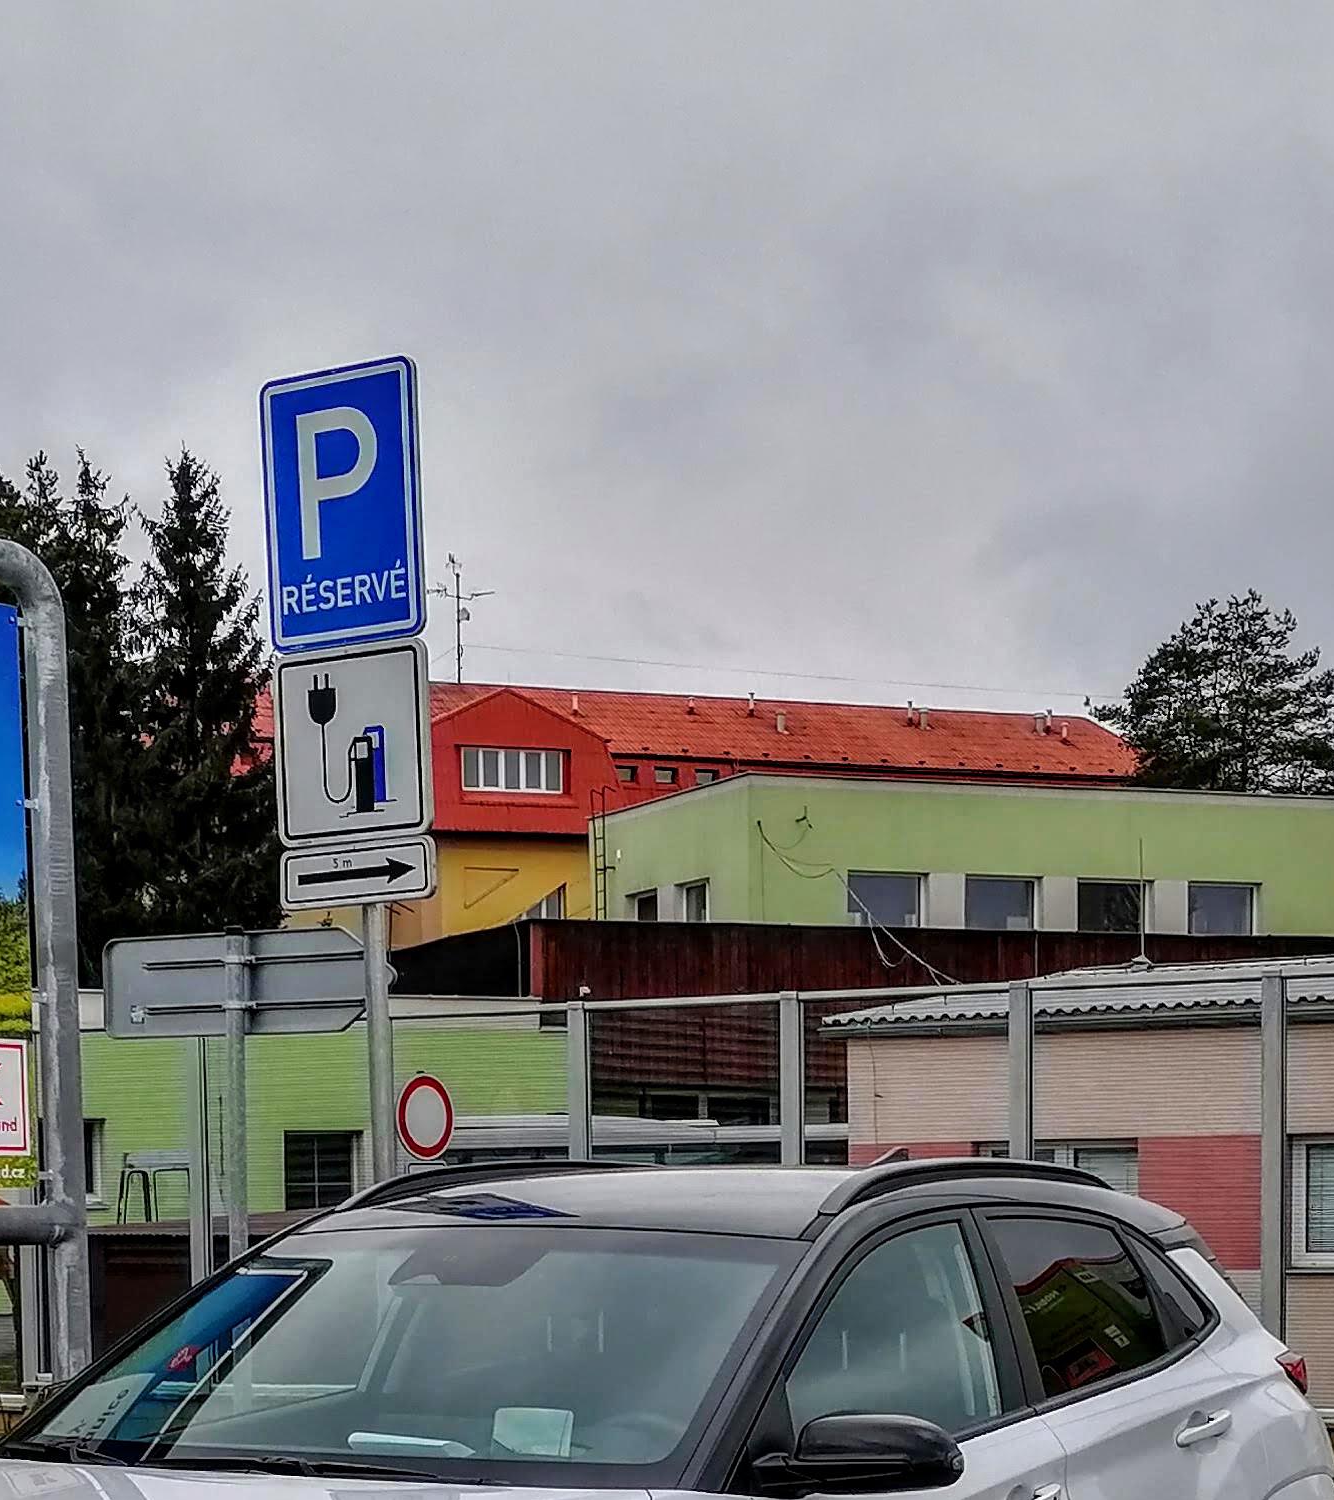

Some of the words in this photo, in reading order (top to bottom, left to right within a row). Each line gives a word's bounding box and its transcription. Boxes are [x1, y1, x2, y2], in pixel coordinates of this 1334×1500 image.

[295, 405, 378, 561] P
[280, 559, 407, 616] RÉSERVÉ
[332, 857, 339, 869] 5
[342, 858, 353, 869] m
